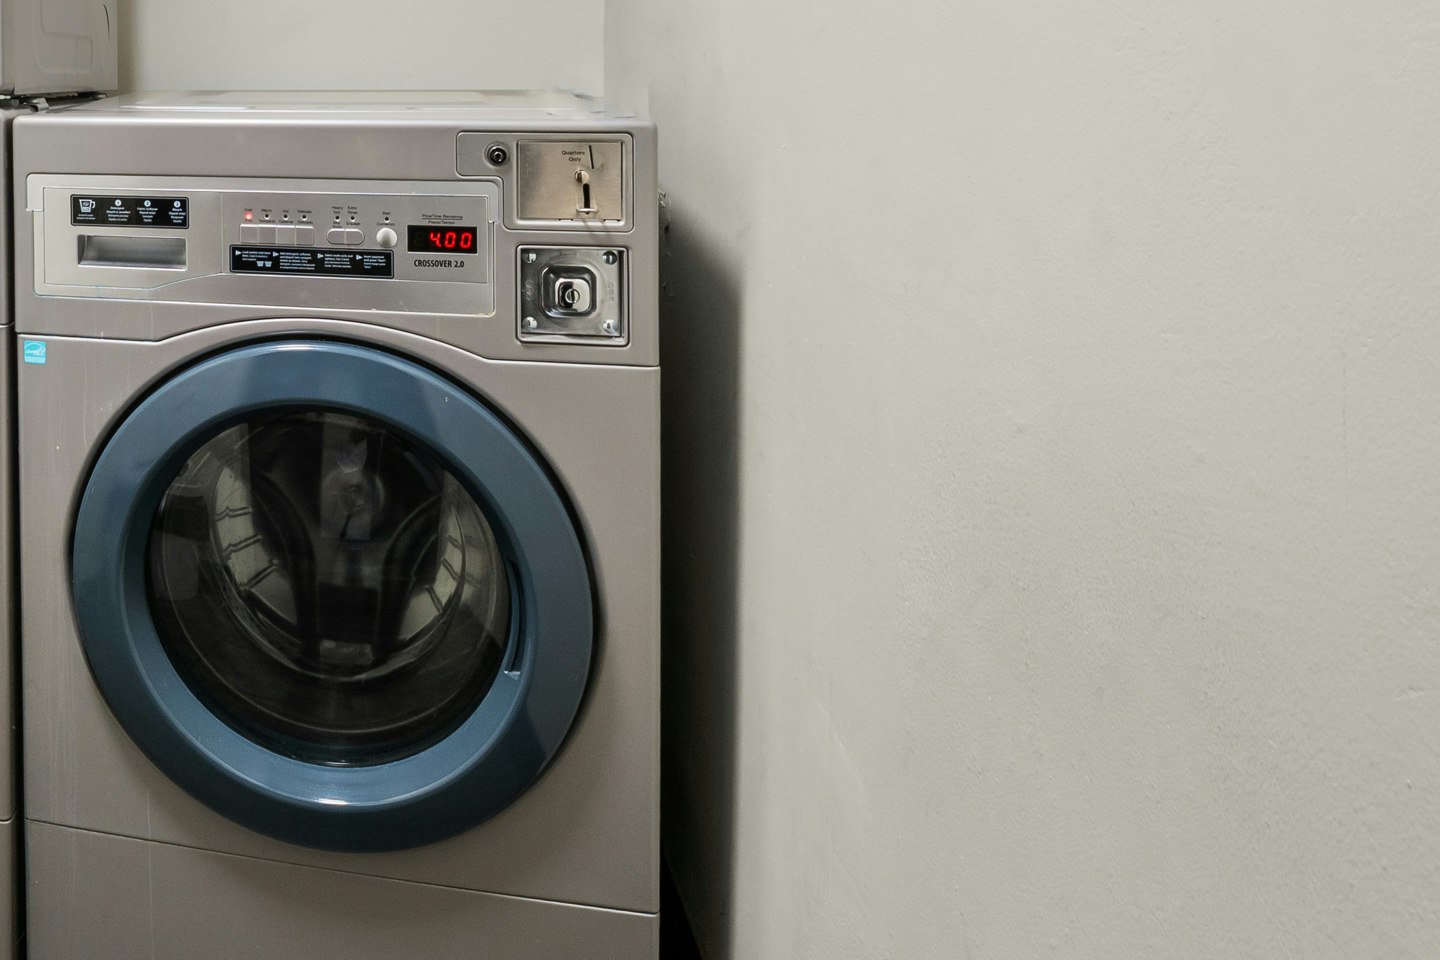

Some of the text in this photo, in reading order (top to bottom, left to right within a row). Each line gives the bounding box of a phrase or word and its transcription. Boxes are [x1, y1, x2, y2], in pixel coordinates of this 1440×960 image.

[429, 231, 472, 248] 4.00
[413, 259, 464, 268] CROSSOVER 2.0
